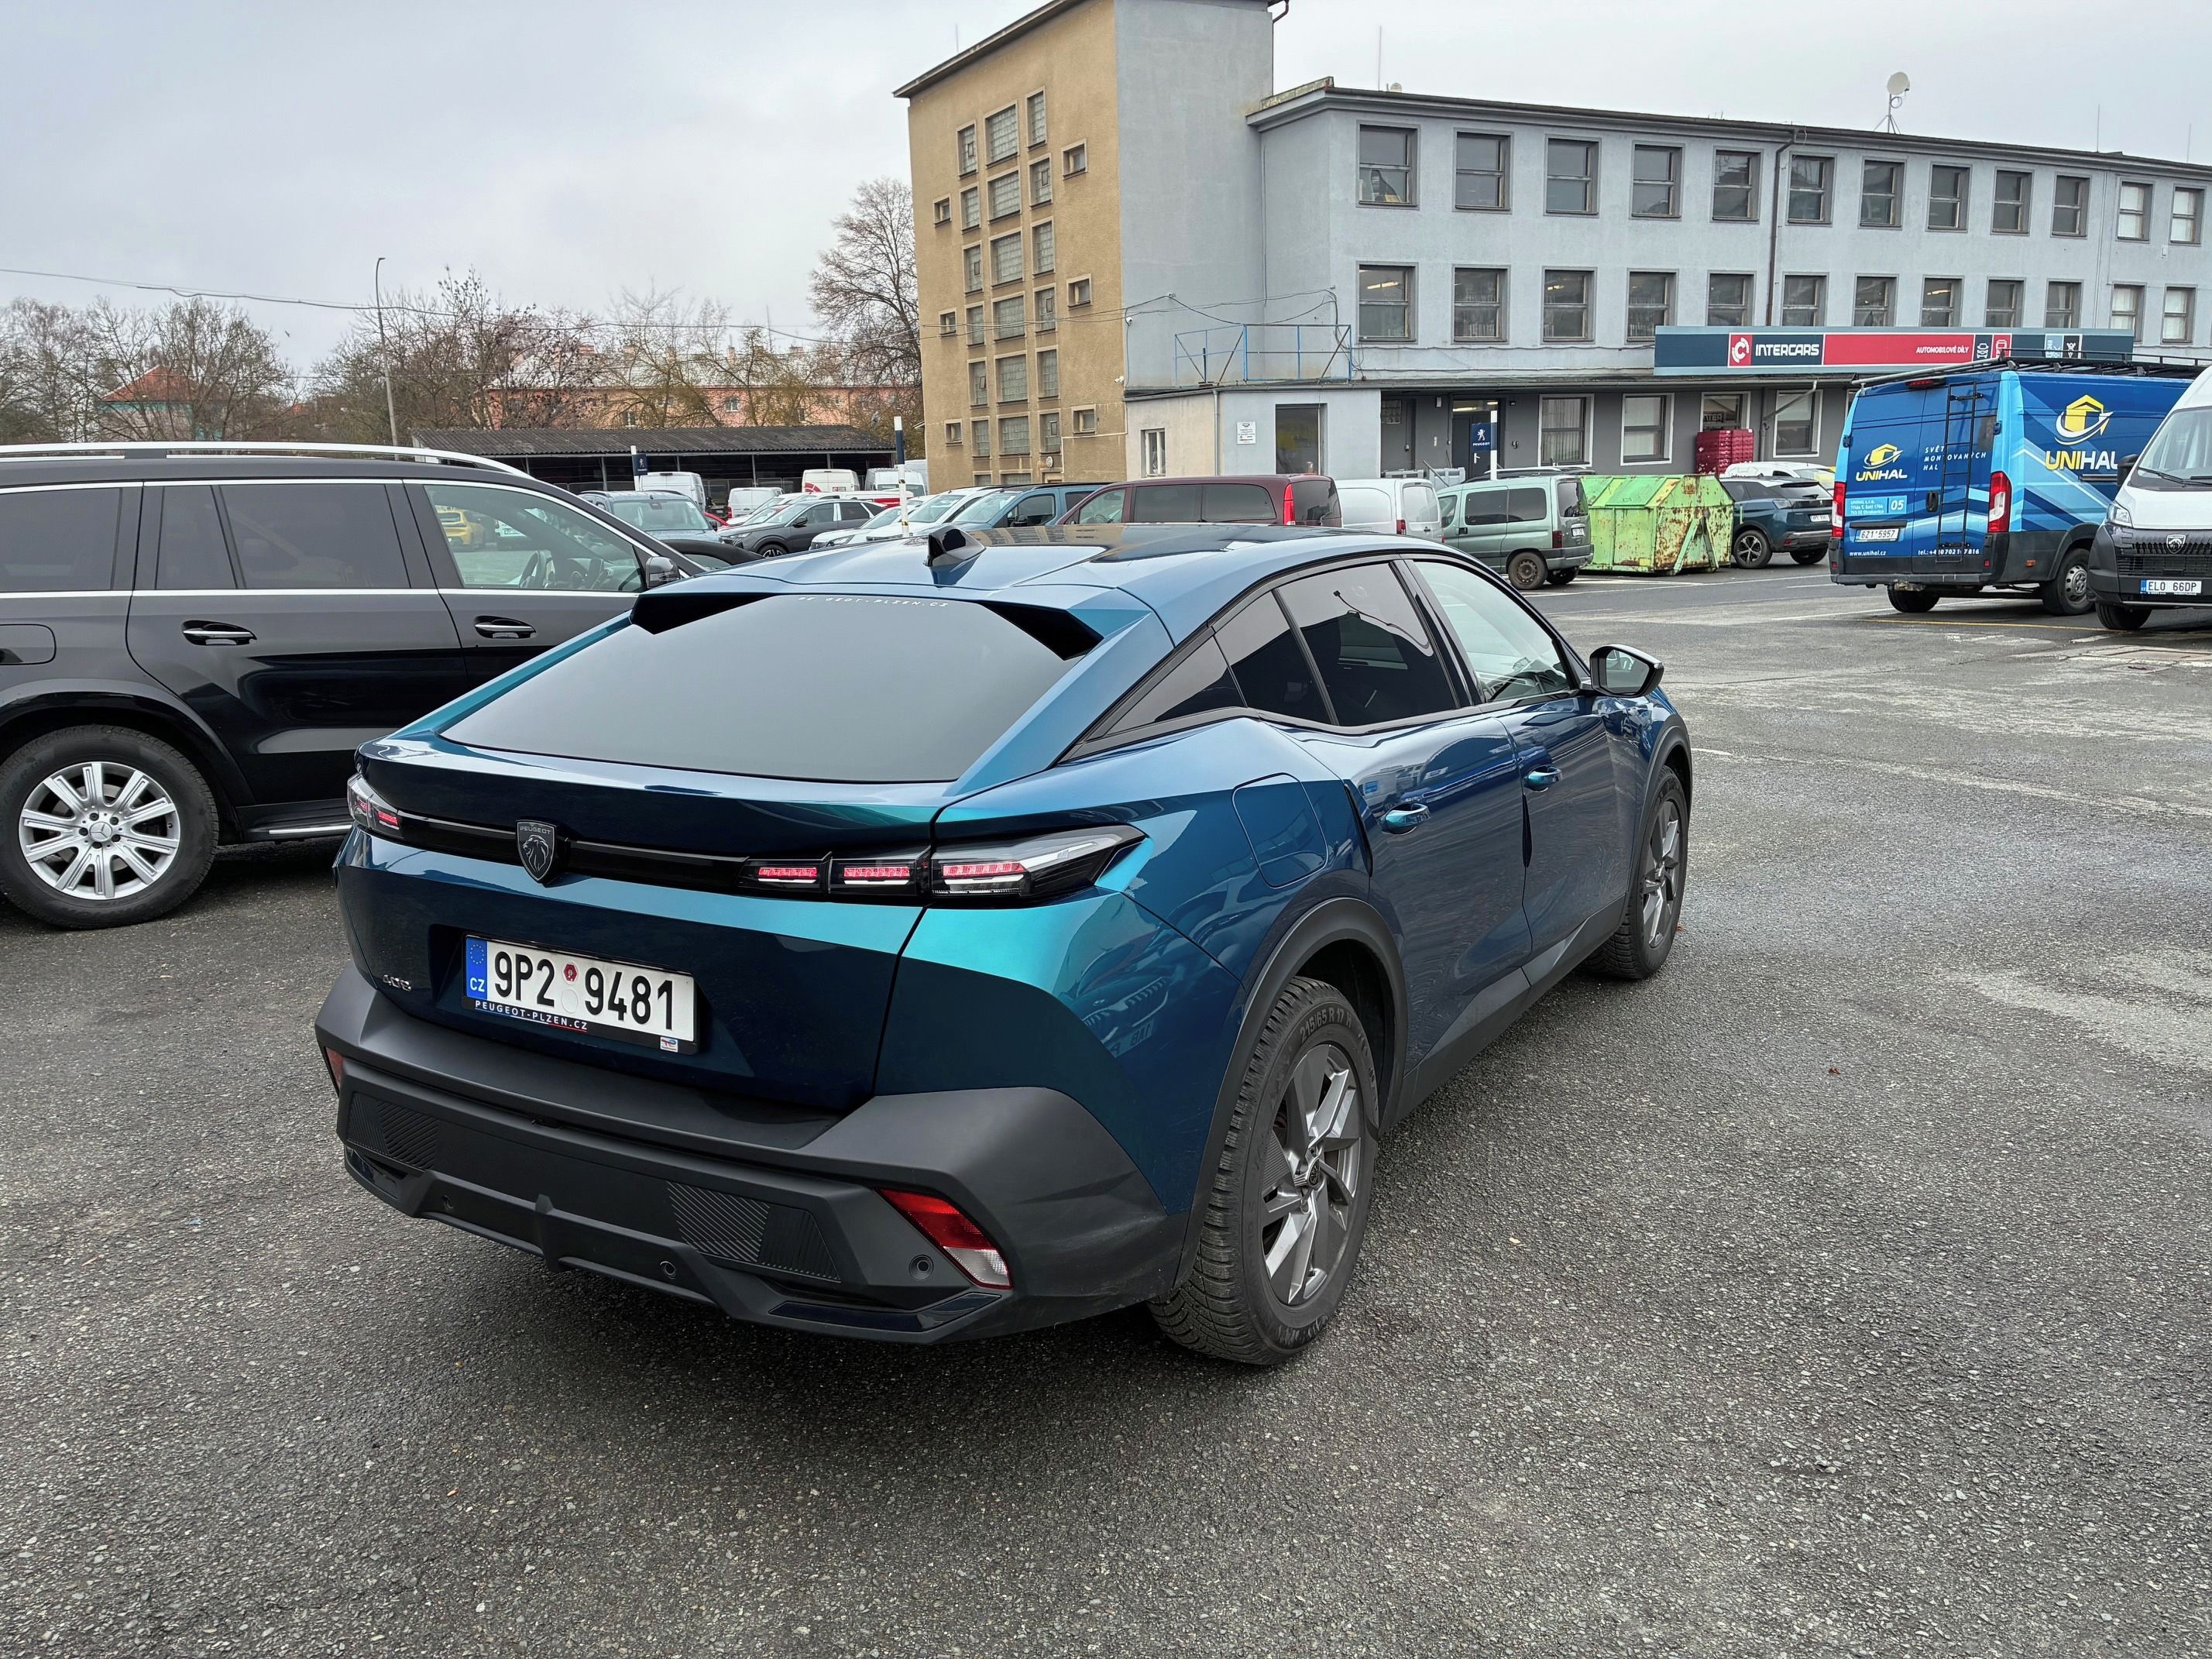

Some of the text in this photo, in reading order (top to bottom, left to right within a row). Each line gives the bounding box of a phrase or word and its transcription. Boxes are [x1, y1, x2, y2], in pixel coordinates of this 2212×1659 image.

[1755, 344, 1819, 356] INTERCARS
[1915, 345, 1969, 354] AUTOMOBILOVÉ DÍLY
[1925, 445, 1945, 454] SVĚT
[1924, 452, 1987, 462] MONOVANÝCH
[2045, 450, 2118, 470] UNIHAL
[1856, 469, 1908, 482] UNIHAL
[1891, 500, 1905, 510] 05
[1878, 530, 1895, 538] 5957
[2172, 582, 2197, 592] 66DP
[520, 826, 551, 835] PEUGEOT
[469, 977, 485, 993] CZ
[494, 951, 673, 1031] 9P2 9481
[475, 999, 588, 1030] PEUGEOT-PLZEN.CZ
[1300, 1008, 1328, 1044] 215/65
[1328, 1007, 1334, 1022] R
[1336, 1007, 1345, 1023] 17
